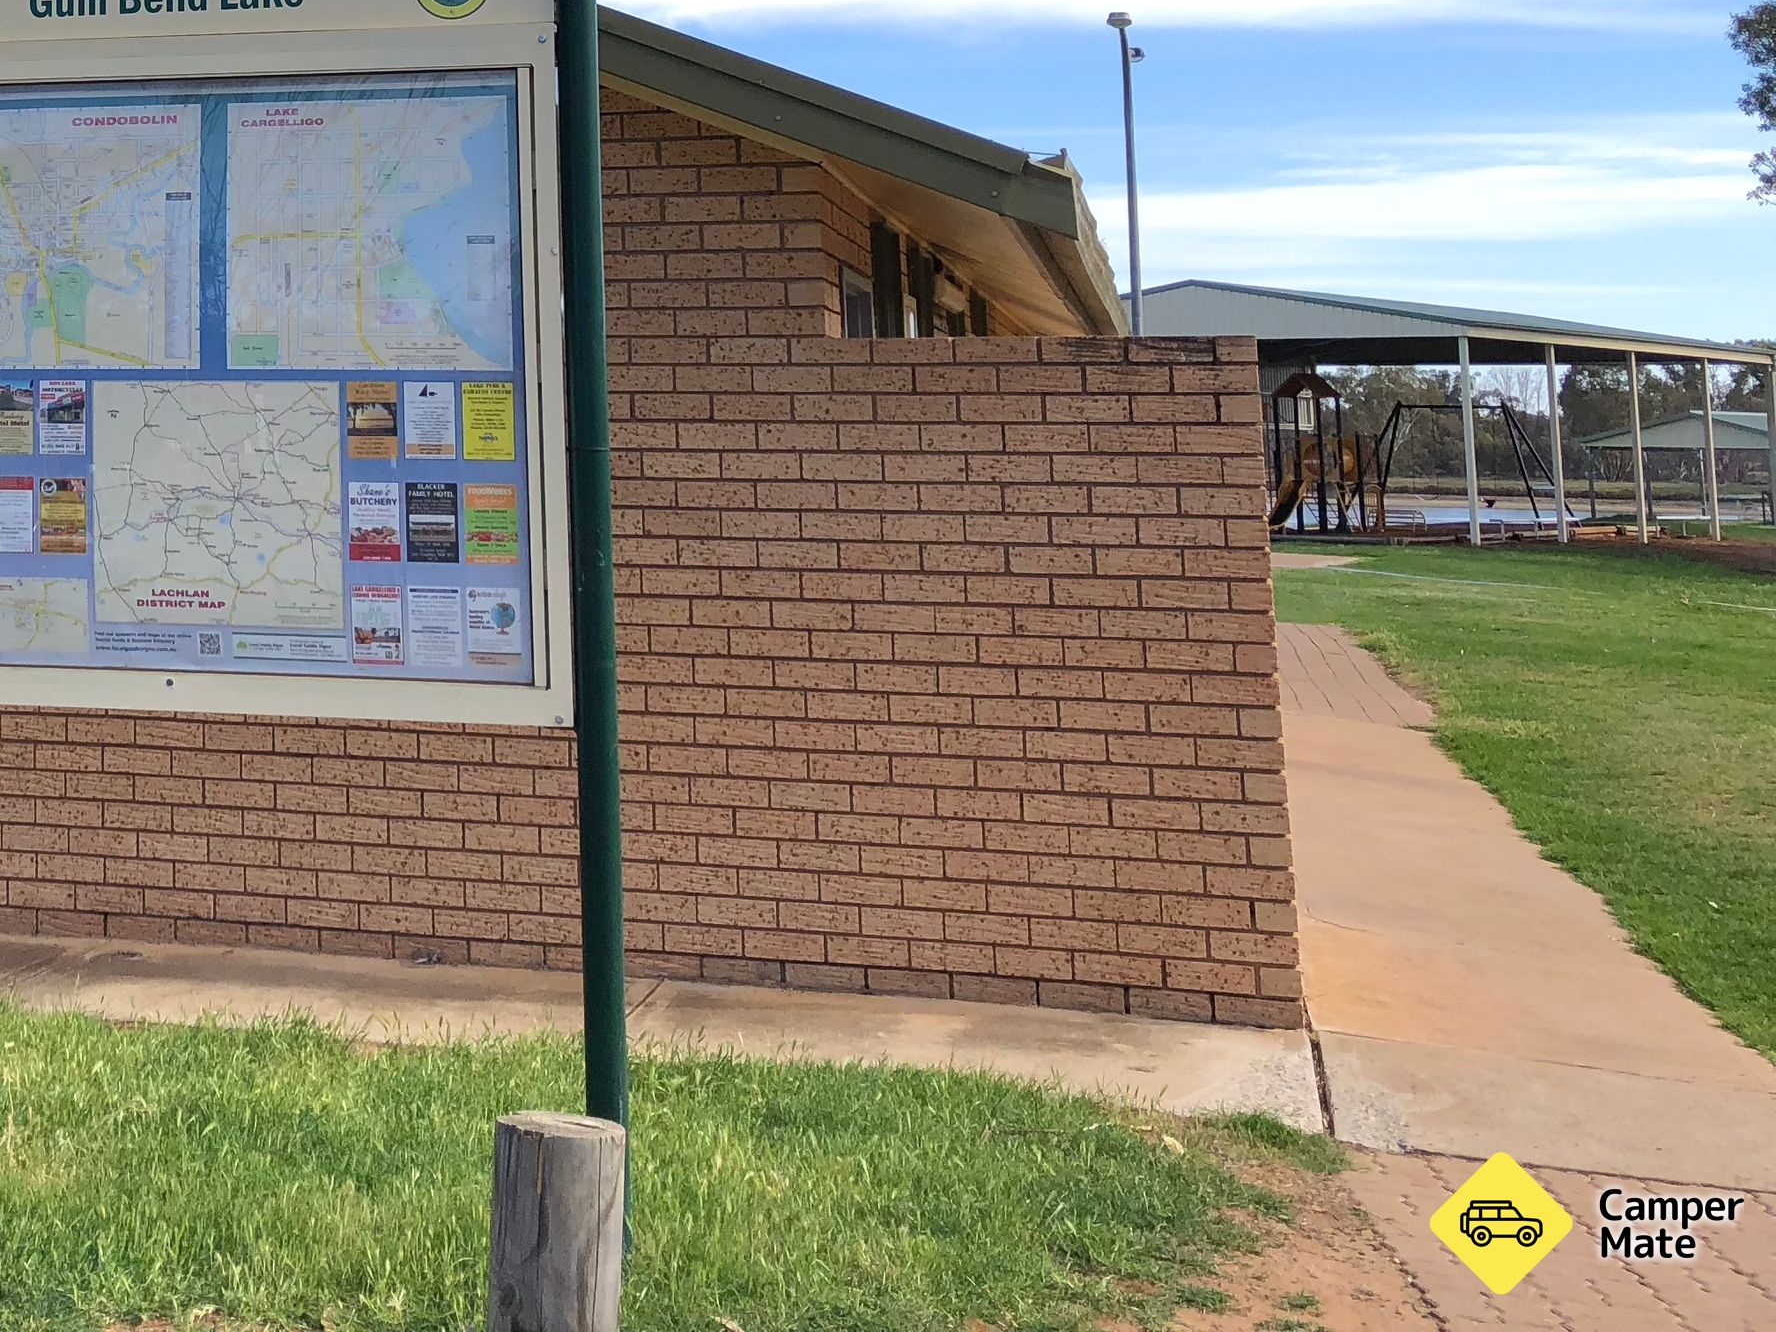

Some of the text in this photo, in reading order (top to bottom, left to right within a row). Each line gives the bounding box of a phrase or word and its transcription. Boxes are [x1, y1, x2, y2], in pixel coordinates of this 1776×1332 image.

[265, 108, 299, 117] LAKE
[71, 115, 178, 127] CONDOBOLIN
[240, 117, 325, 128] CARGELLIGO
[408, 490, 431, 498] FAMILY
[350, 497, 398, 506] BUTCHERY
[151, 589, 210, 598] LACHLAN
[136, 599, 226, 609] DISTRICT MAP
